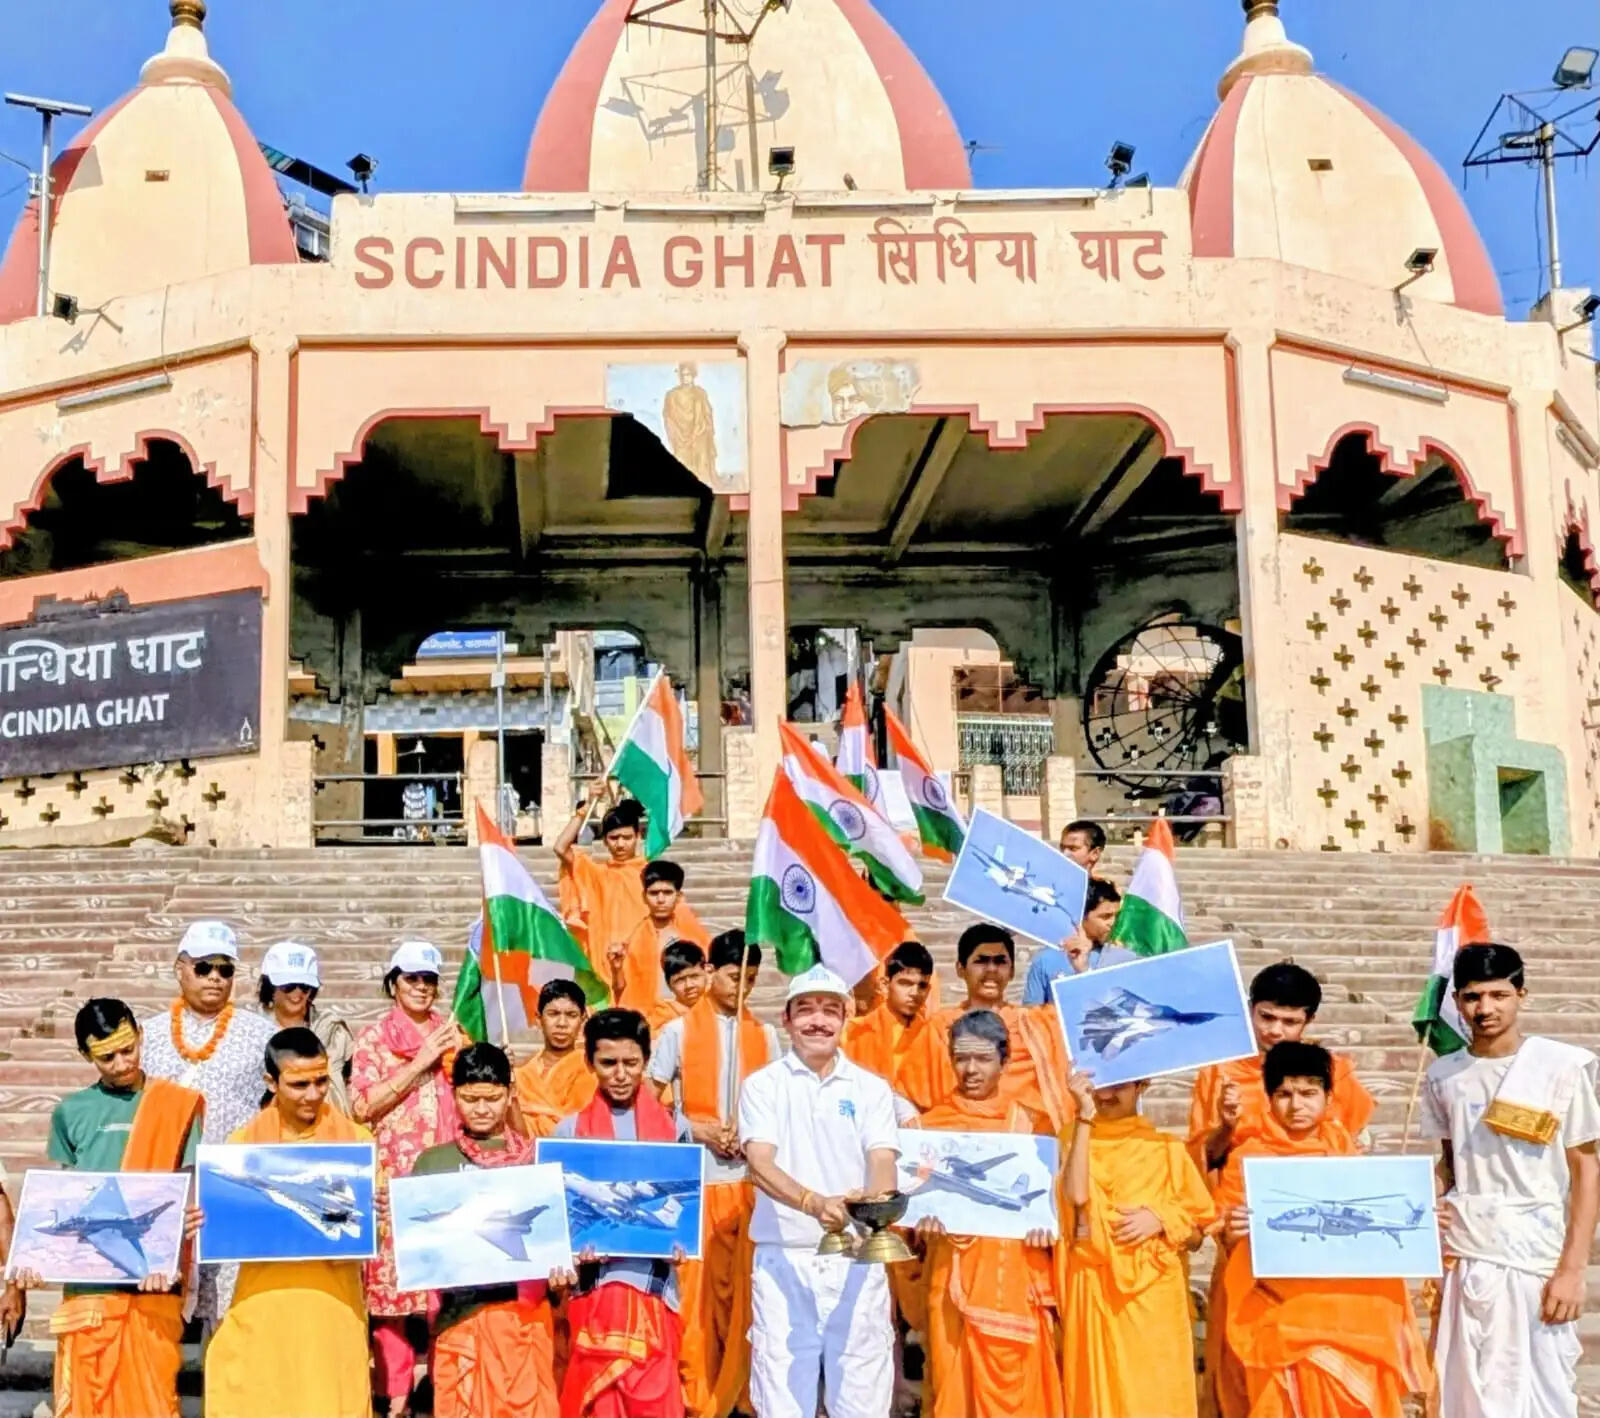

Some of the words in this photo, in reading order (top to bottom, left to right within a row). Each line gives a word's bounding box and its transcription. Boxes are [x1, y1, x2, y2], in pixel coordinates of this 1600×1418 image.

[355, 237, 638, 288] SCINDIA
[664, 236, 844, 286] GHAT
[1070, 230, 1169, 281] घाट
[0, 639, 116, 693] न्धिया
[127, 629, 205, 674] घाट
[0, 703, 91, 738] CINDIA
[96, 692, 169, 727] GHAT
